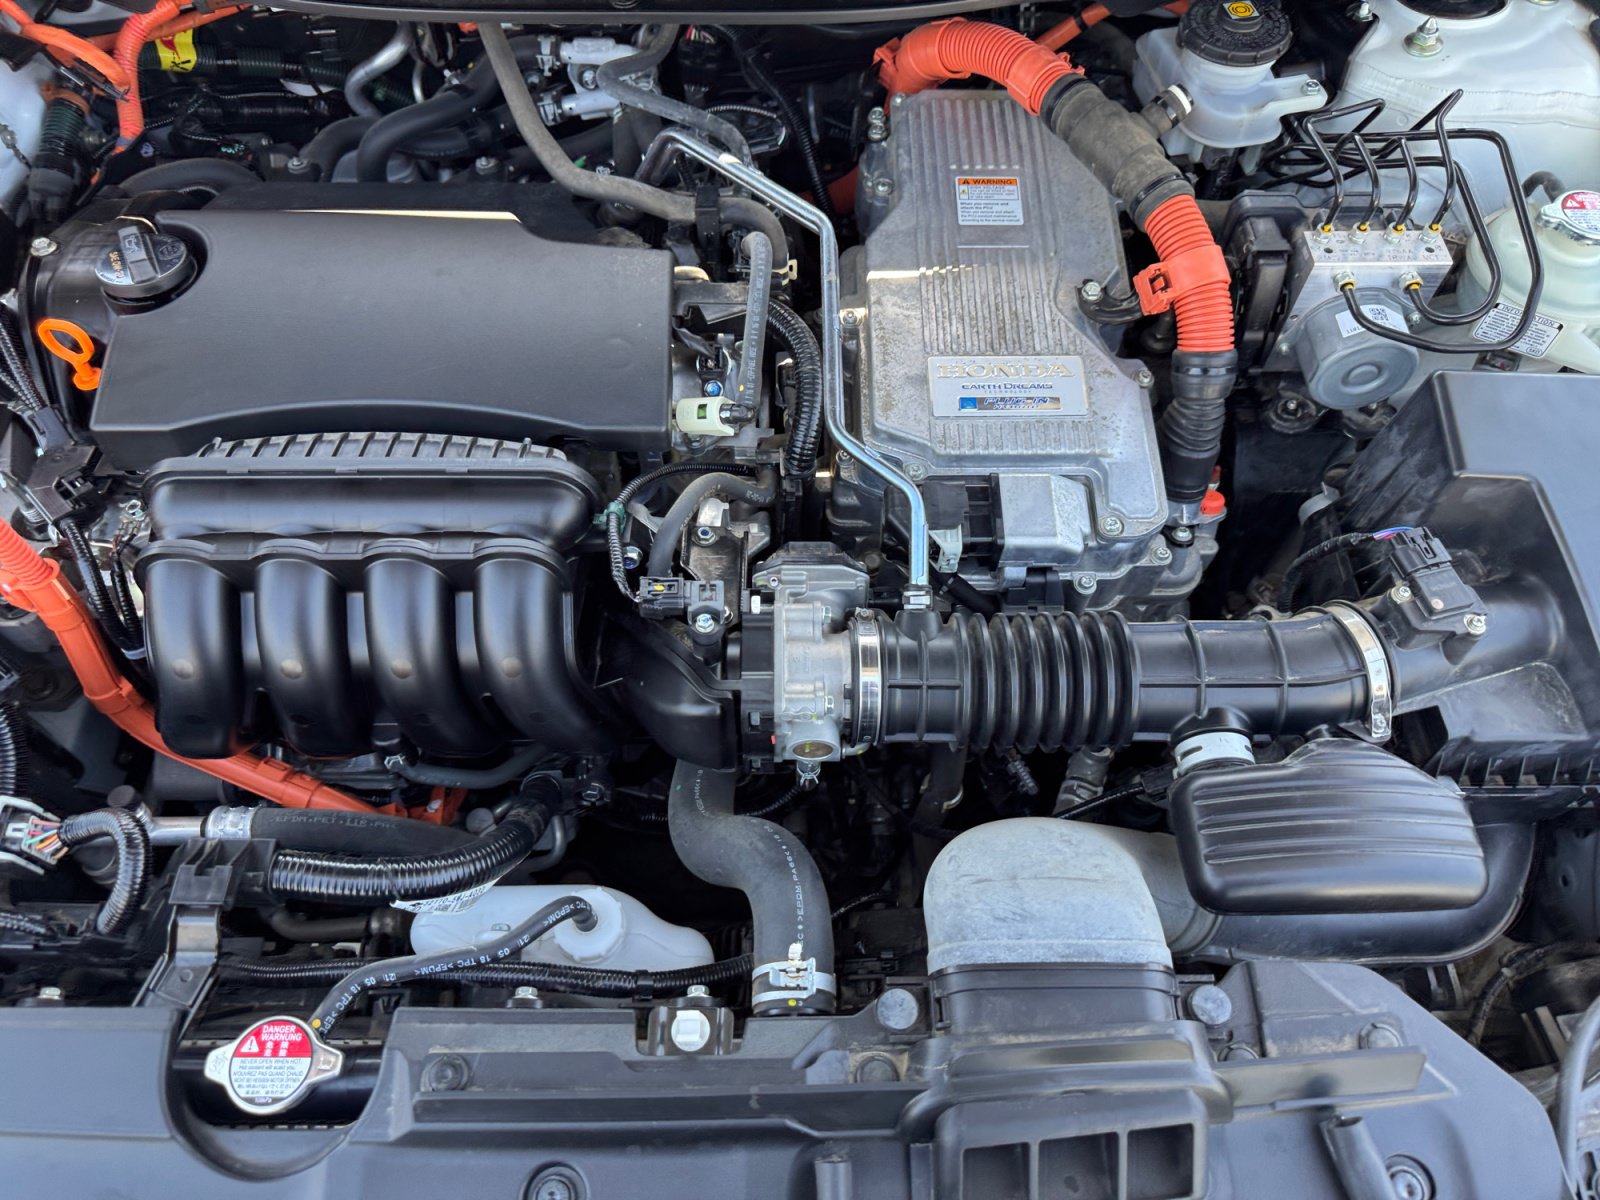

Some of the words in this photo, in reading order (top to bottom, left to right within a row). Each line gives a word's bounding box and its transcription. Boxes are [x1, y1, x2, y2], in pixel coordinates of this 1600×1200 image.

[1502, 305, 1555, 327] INFOTION
[937, 363, 1074, 379] HONDA
[498, 947, 510, 958] 05
[457, 958, 477, 968] TPC
[480, 954, 492, 964] 18
[364, 976, 376, 986] 05
[350, 984, 361, 994] 18
[336, 993, 353, 1011] TPC
[263, 1025, 296, 1033] DANGER
[262, 1033, 302, 1041] WARNUNG
